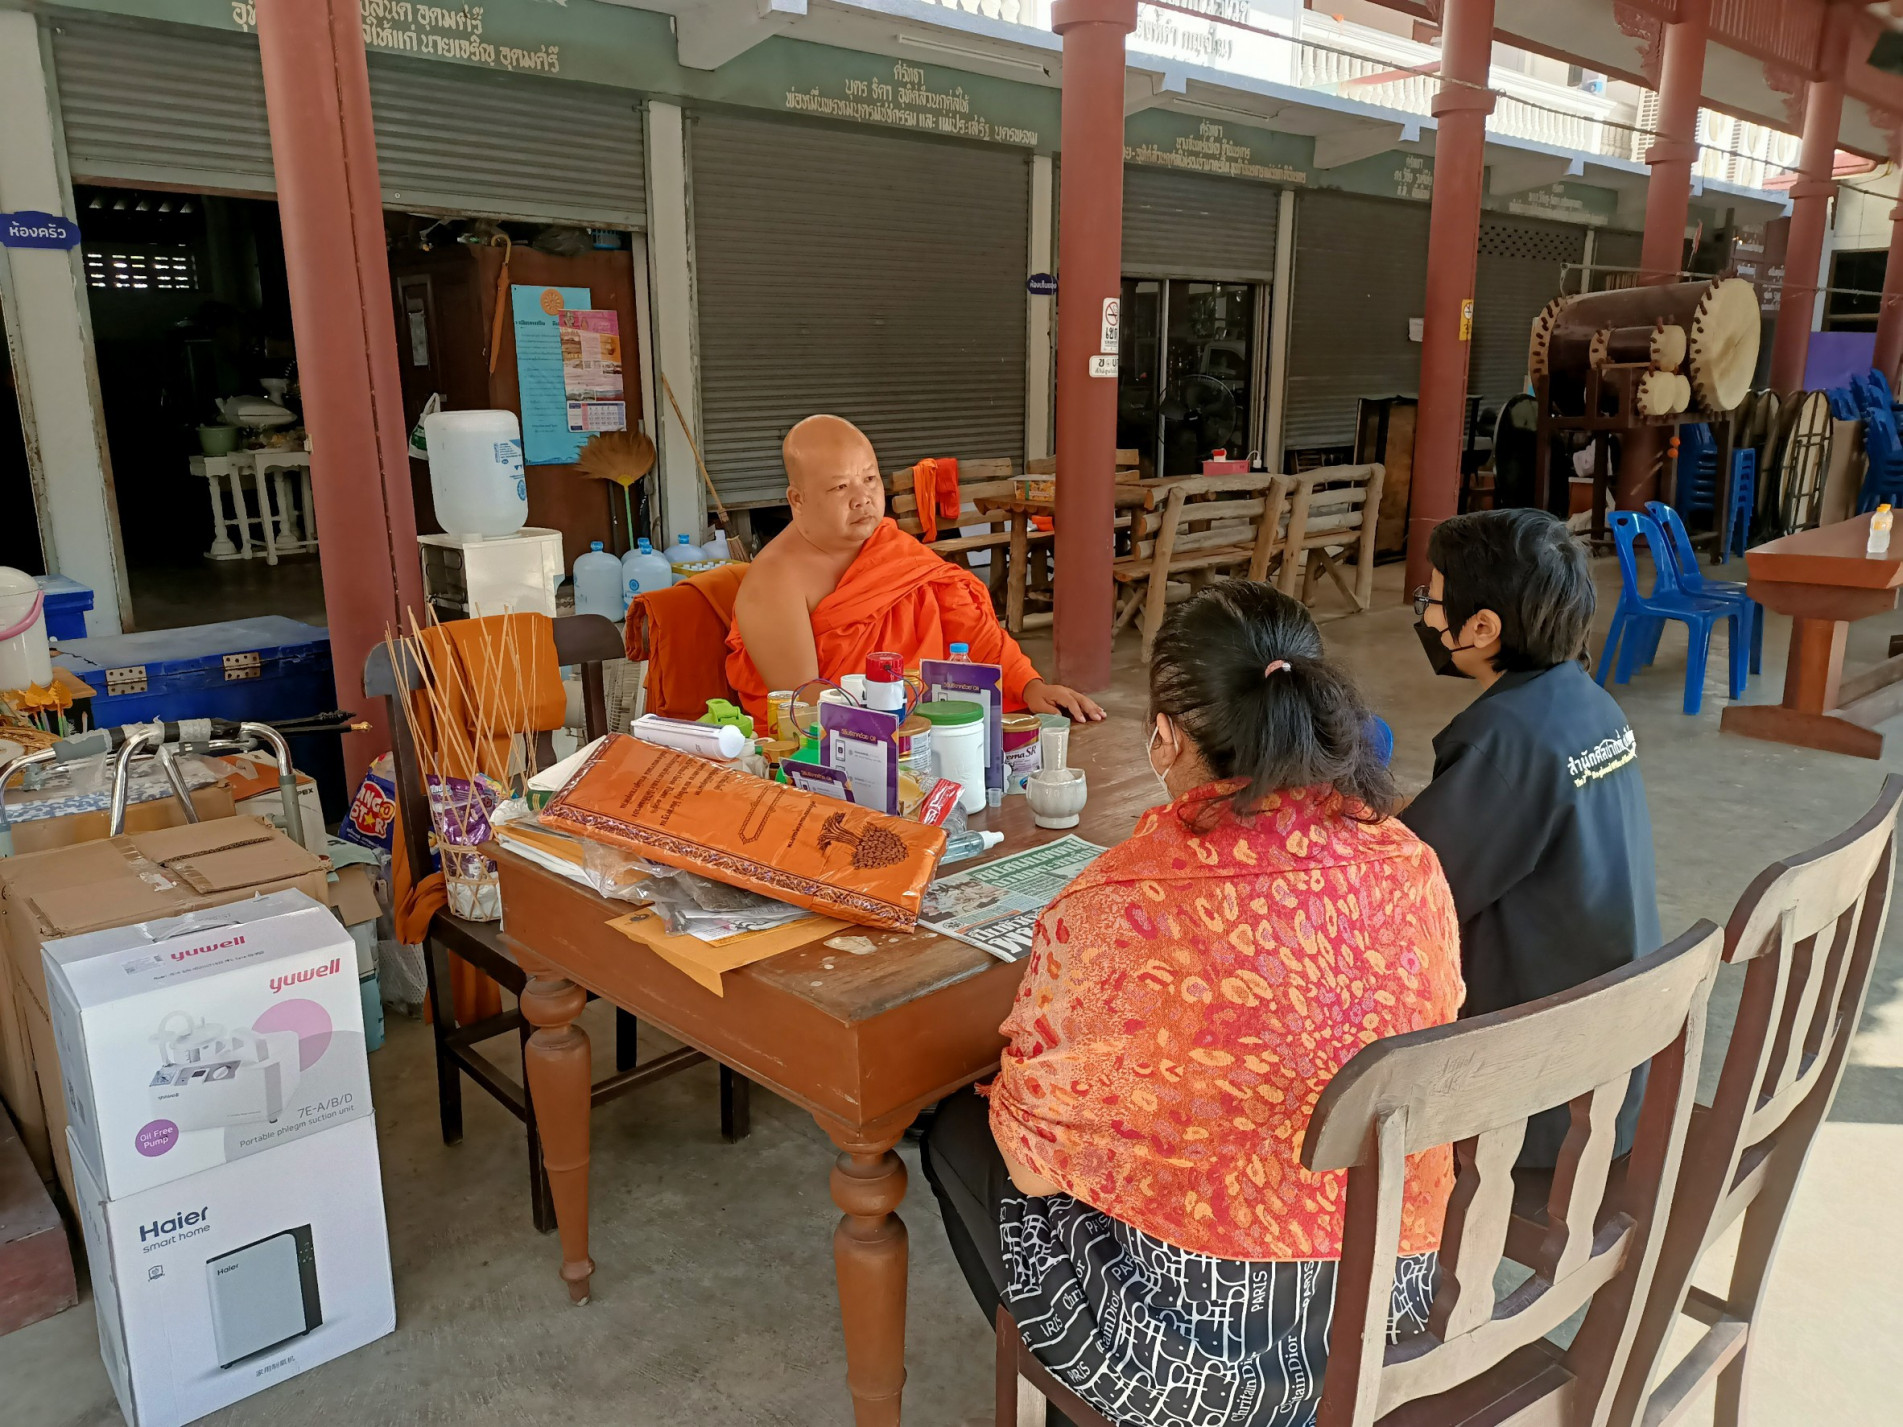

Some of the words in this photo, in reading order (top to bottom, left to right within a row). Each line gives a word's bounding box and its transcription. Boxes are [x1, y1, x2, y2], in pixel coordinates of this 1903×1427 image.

[9, 221, 67, 239] ห้องครัว
[170, 936, 245, 961] yuwell
[269, 957, 341, 993] yuwell
[298, 1093, 353, 1118] 7E-A/B/D
[140, 1131, 152, 1143] Oil
[153, 1125, 174, 1138] Free
[240, 1128, 275, 1147] Portable
[277, 1121, 306, 1137] phlegm
[308, 1112, 337, 1125] suction
[339, 1105, 354, 1115] unit
[143, 1136, 169, 1149] Pump
[139, 1206, 208, 1242] Haier
[143, 1236, 177, 1253] smart
[179, 1224, 211, 1241] home
[217, 1263, 239, 1276] Haier
[1251, 1270, 1267, 1312] PARIS
